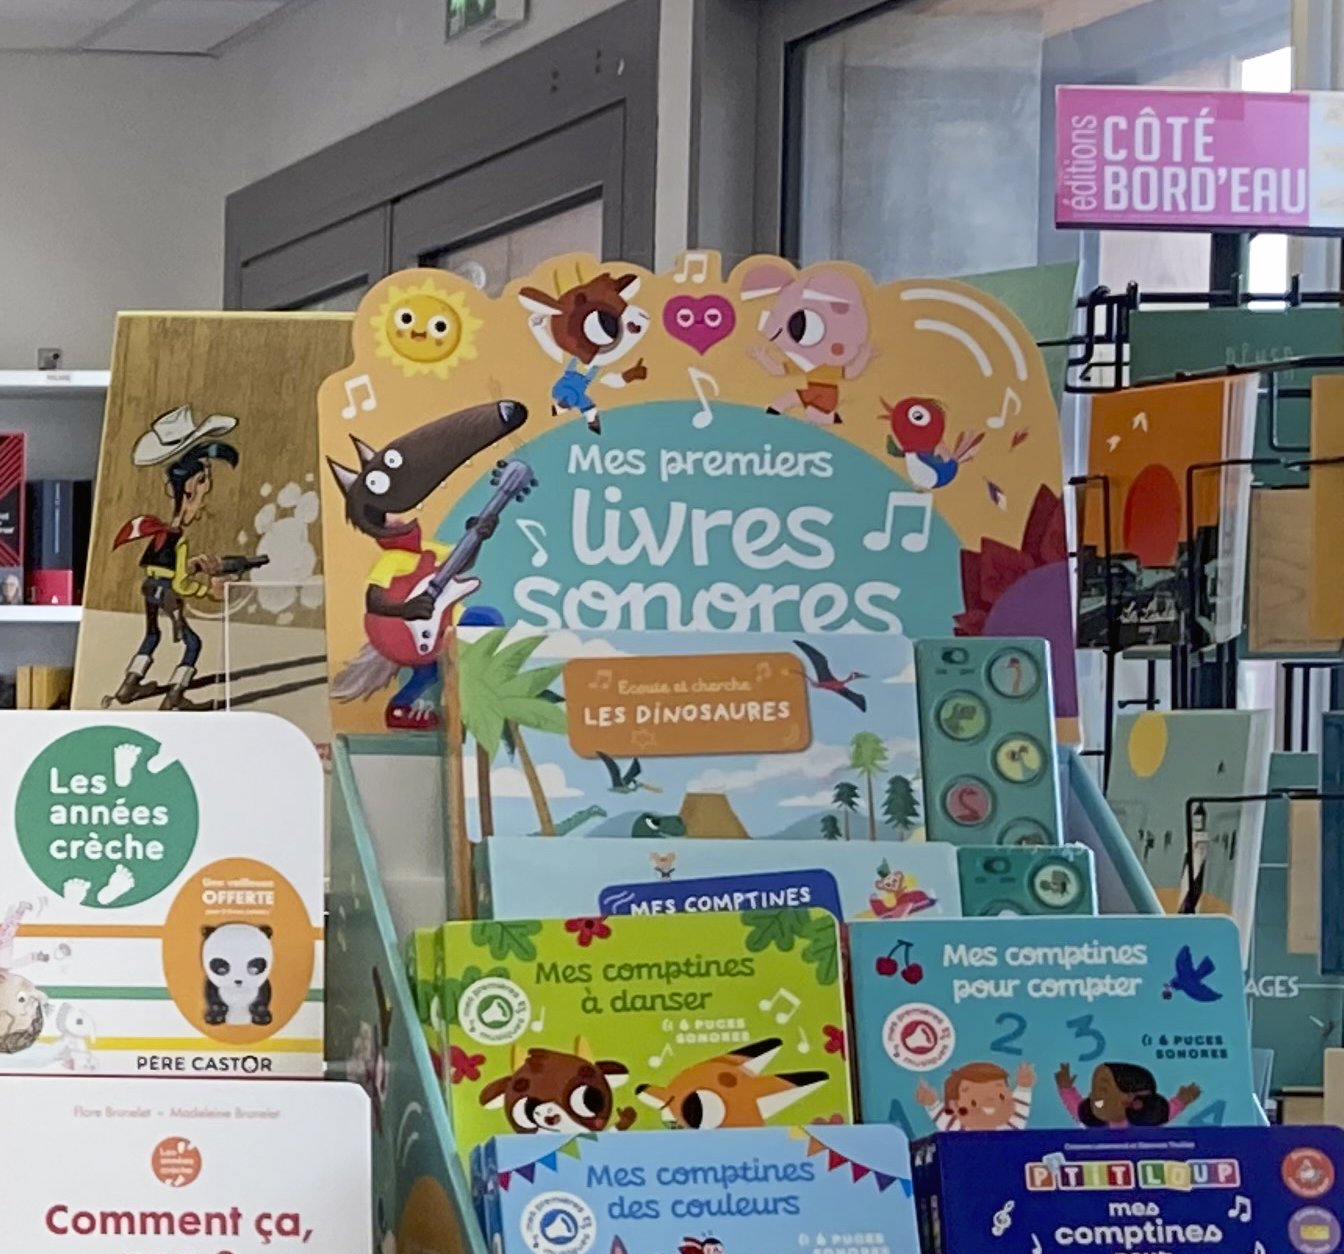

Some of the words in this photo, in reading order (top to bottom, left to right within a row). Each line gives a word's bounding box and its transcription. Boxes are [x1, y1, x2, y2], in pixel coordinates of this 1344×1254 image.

[1103, 106, 1216, 163] CÔTÉ
[1061, 114, 1098, 212] éditions
[1103, 165, 1307, 214] BORD'EAU
[567, 444, 647, 476] Mes
[659, 444, 834, 483] premiers
[571, 485, 836, 570] livres
[513, 575, 904, 636] sonores
[584, 706, 626, 727] LES
[49, 767, 108, 795] Les
[48, 799, 169, 827] années
[48, 833, 165, 862] crèche
[201, 889, 275, 906] OFFERTE
[684, 887, 812, 913] COMPTINES
[535, 960, 593, 985] Mes
[602, 954, 756, 985] comptines
[942, 944, 998, 967] Mes
[1005, 942, 1149, 970] comptines
[580, 992, 603, 1015] à
[609, 988, 713, 1014] danser
[952, 978, 1017, 1003] pour
[1026, 976, 1143, 1002] compter
[989, 1011, 1029, 1057] 2
[1065, 1013, 1107, 1063] 3
[137, 1053, 186, 1073] PÈRE
[191, 1055, 273, 1074] CASTOR
[1155, 1048, 1229, 1060] SONORES
[586, 1163, 646, 1188] Mes
[656, 1158, 816, 1189] comptines
[608, 1195, 661, 1220] des
[670, 1192, 802, 1219] couleurs
[1108, 1202, 1161, 1217] mes
[44, 1204, 243, 1237] Comment
[254, 1207, 314, 1244] ça,
[1054, 1218, 1223, 1250] comptines
